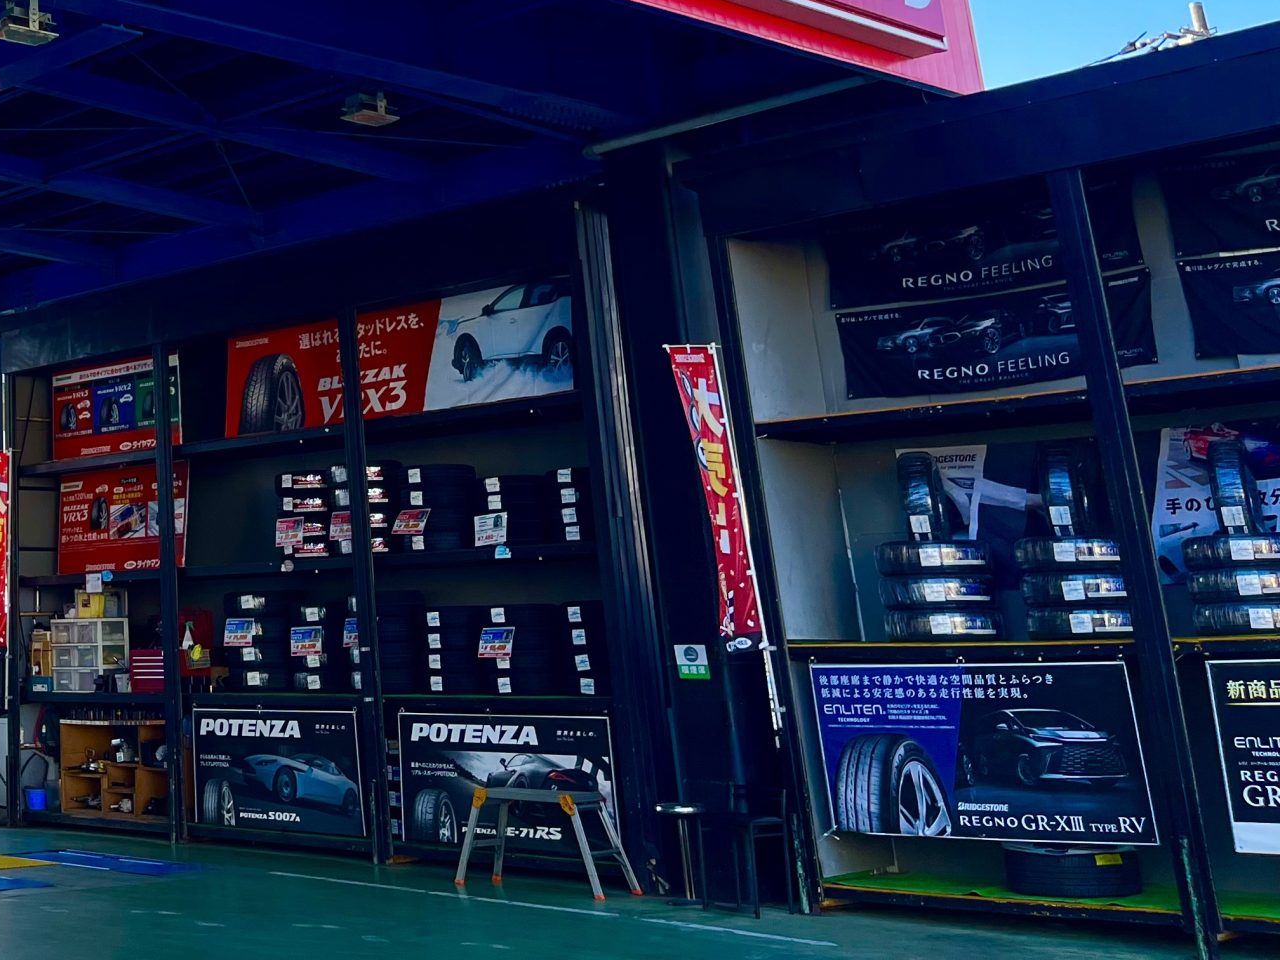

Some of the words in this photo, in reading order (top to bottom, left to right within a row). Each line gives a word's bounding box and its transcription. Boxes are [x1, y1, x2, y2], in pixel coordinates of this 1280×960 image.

[902, 270, 972, 288] REGNO
[981, 255, 1053, 278] FEELING
[299, 313, 424, 350] 選ばれるタッドレスを、
[917, 363, 989, 380] REGNO
[997, 351, 1070, 373] FEELING
[317, 363, 407, 391] BLZAK
[319, 380, 407, 424] VX3
[819, 673, 1054, 686] 後部座席まで静かで快適な空間品質とふらつき
[820, 687, 1029, 699] 低減による安定感のある走行性能を実現。
[200, 718, 301, 738] POTENZA
[411, 723, 539, 745] POTENZA
[1240, 770, 1279, 782] REG
[239, 812, 267, 820] POTENZA
[268, 811, 301, 822] S007A
[958, 802, 1009, 812] BRIDGESTONE
[461, 826, 497, 835] PTENZA
[959, 815, 1019, 828] REGNO
[1089, 823, 1118, 833] TYPE
[1118, 816, 1146, 833] RV
